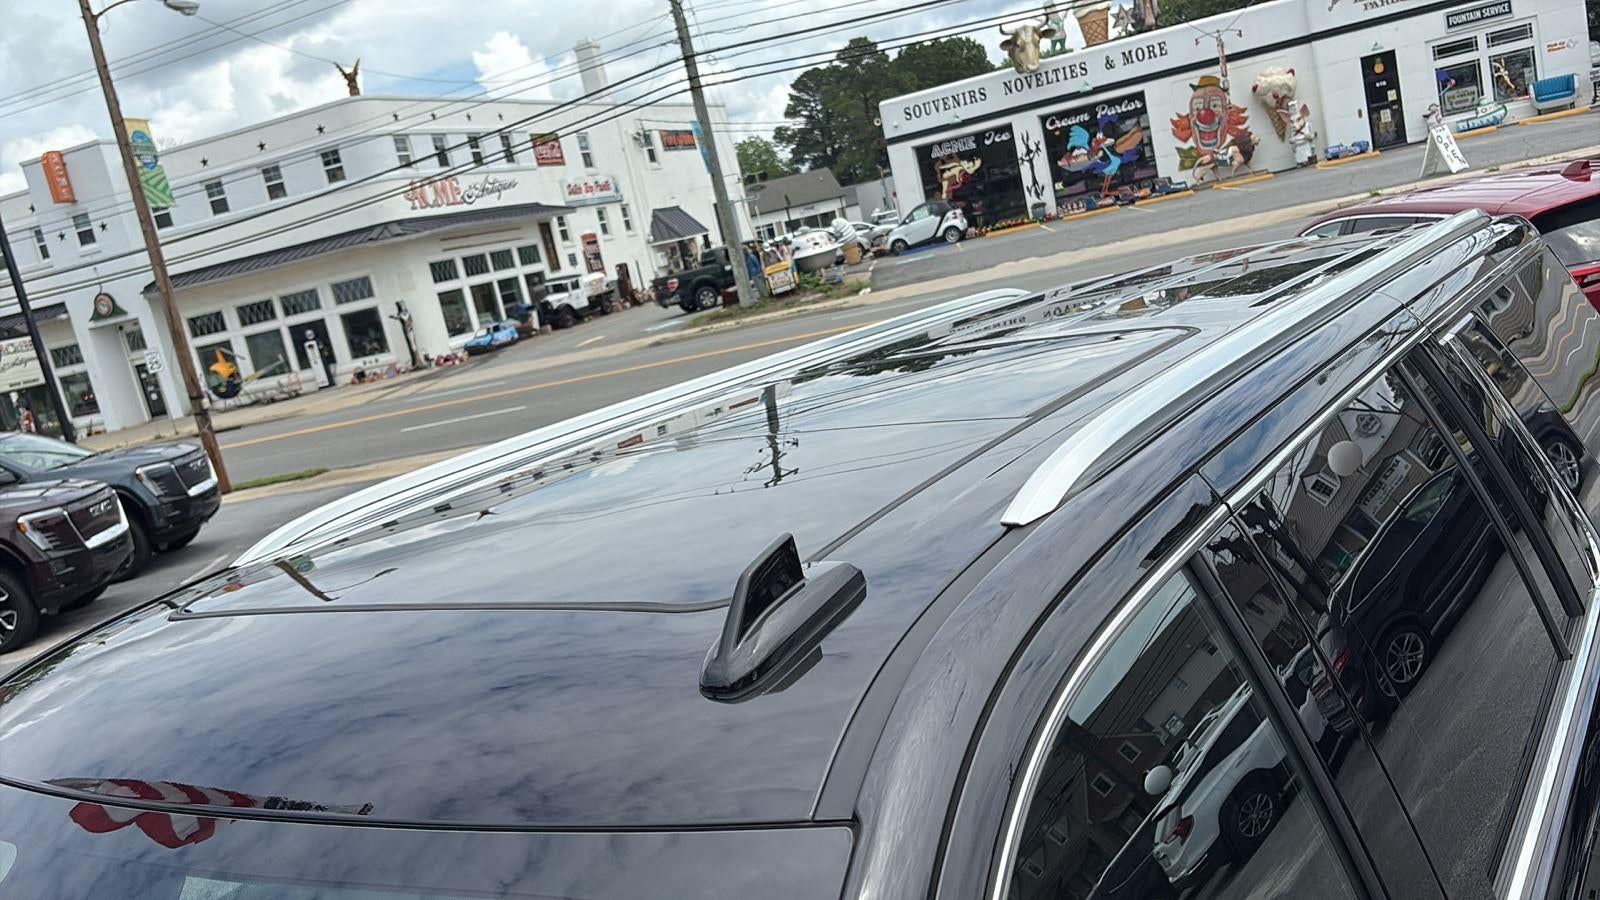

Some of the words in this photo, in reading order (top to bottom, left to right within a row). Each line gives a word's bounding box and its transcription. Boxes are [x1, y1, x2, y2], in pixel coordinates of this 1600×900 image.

[1448, 9, 1482, 26] FOUNTAIN
[1482, 3, 1510, 18] SERVICE
[903, 87, 988, 121] SOUVENIRS
[1003, 61, 1089, 96] NOVELTIES
[1104, 55, 1116, 71] &
[1122, 41, 1168, 66] MORE
[1045, 111, 1091, 131] Cream
[1094, 98, 1144, 120] Parlor
[930, 135, 977, 159] ACME
[984, 130, 1012, 146] Ice
[403, 175, 464, 211] ACME
